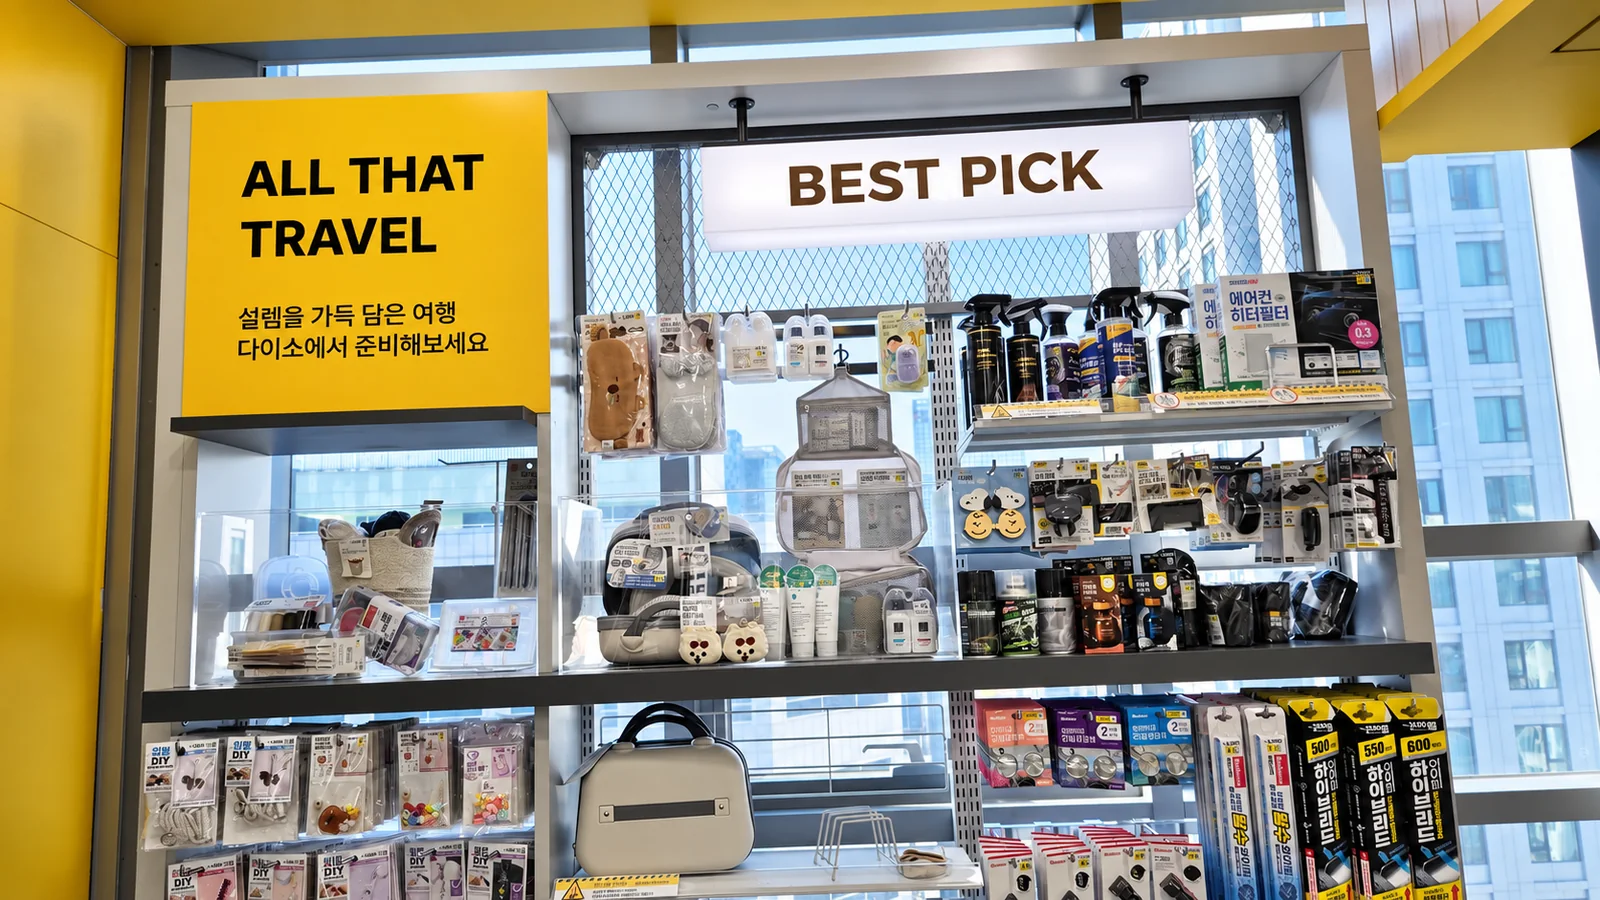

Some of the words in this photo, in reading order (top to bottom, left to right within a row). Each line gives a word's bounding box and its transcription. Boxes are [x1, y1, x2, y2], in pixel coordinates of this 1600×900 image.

[241, 158, 336, 198] ALL
[348, 153, 485, 194] THAT
[788, 158, 940, 206] BEST
[960, 149, 1103, 198] PICK
[240, 216, 438, 258] TRAVEL
[1229, 289, 1273, 306] 에어컨
[238, 305, 305, 331] 설렘을
[311, 303, 356, 328] 가득
[362, 302, 406, 326] 담은
[412, 300, 457, 325] 여행
[1230, 305, 1289, 322] 히터필터
[1353, 327, 1372, 339] 0.3
[237, 335, 348, 361] 다이소에서
[354, 331, 489, 358] 준비해보세요
[1311, 739, 1330, 755] 500
[1364, 741, 1385, 757] 550
[1407, 738, 1430, 753] 600
[151, 756, 170, 765] DIY
[232, 751, 250, 759] DIY
[409, 857, 426, 866] DIY
[473, 856, 489, 866] DIY
[253, 869, 269, 878] DIY
[324, 865, 344, 876] DIY
[174, 877, 193, 888] DIY
